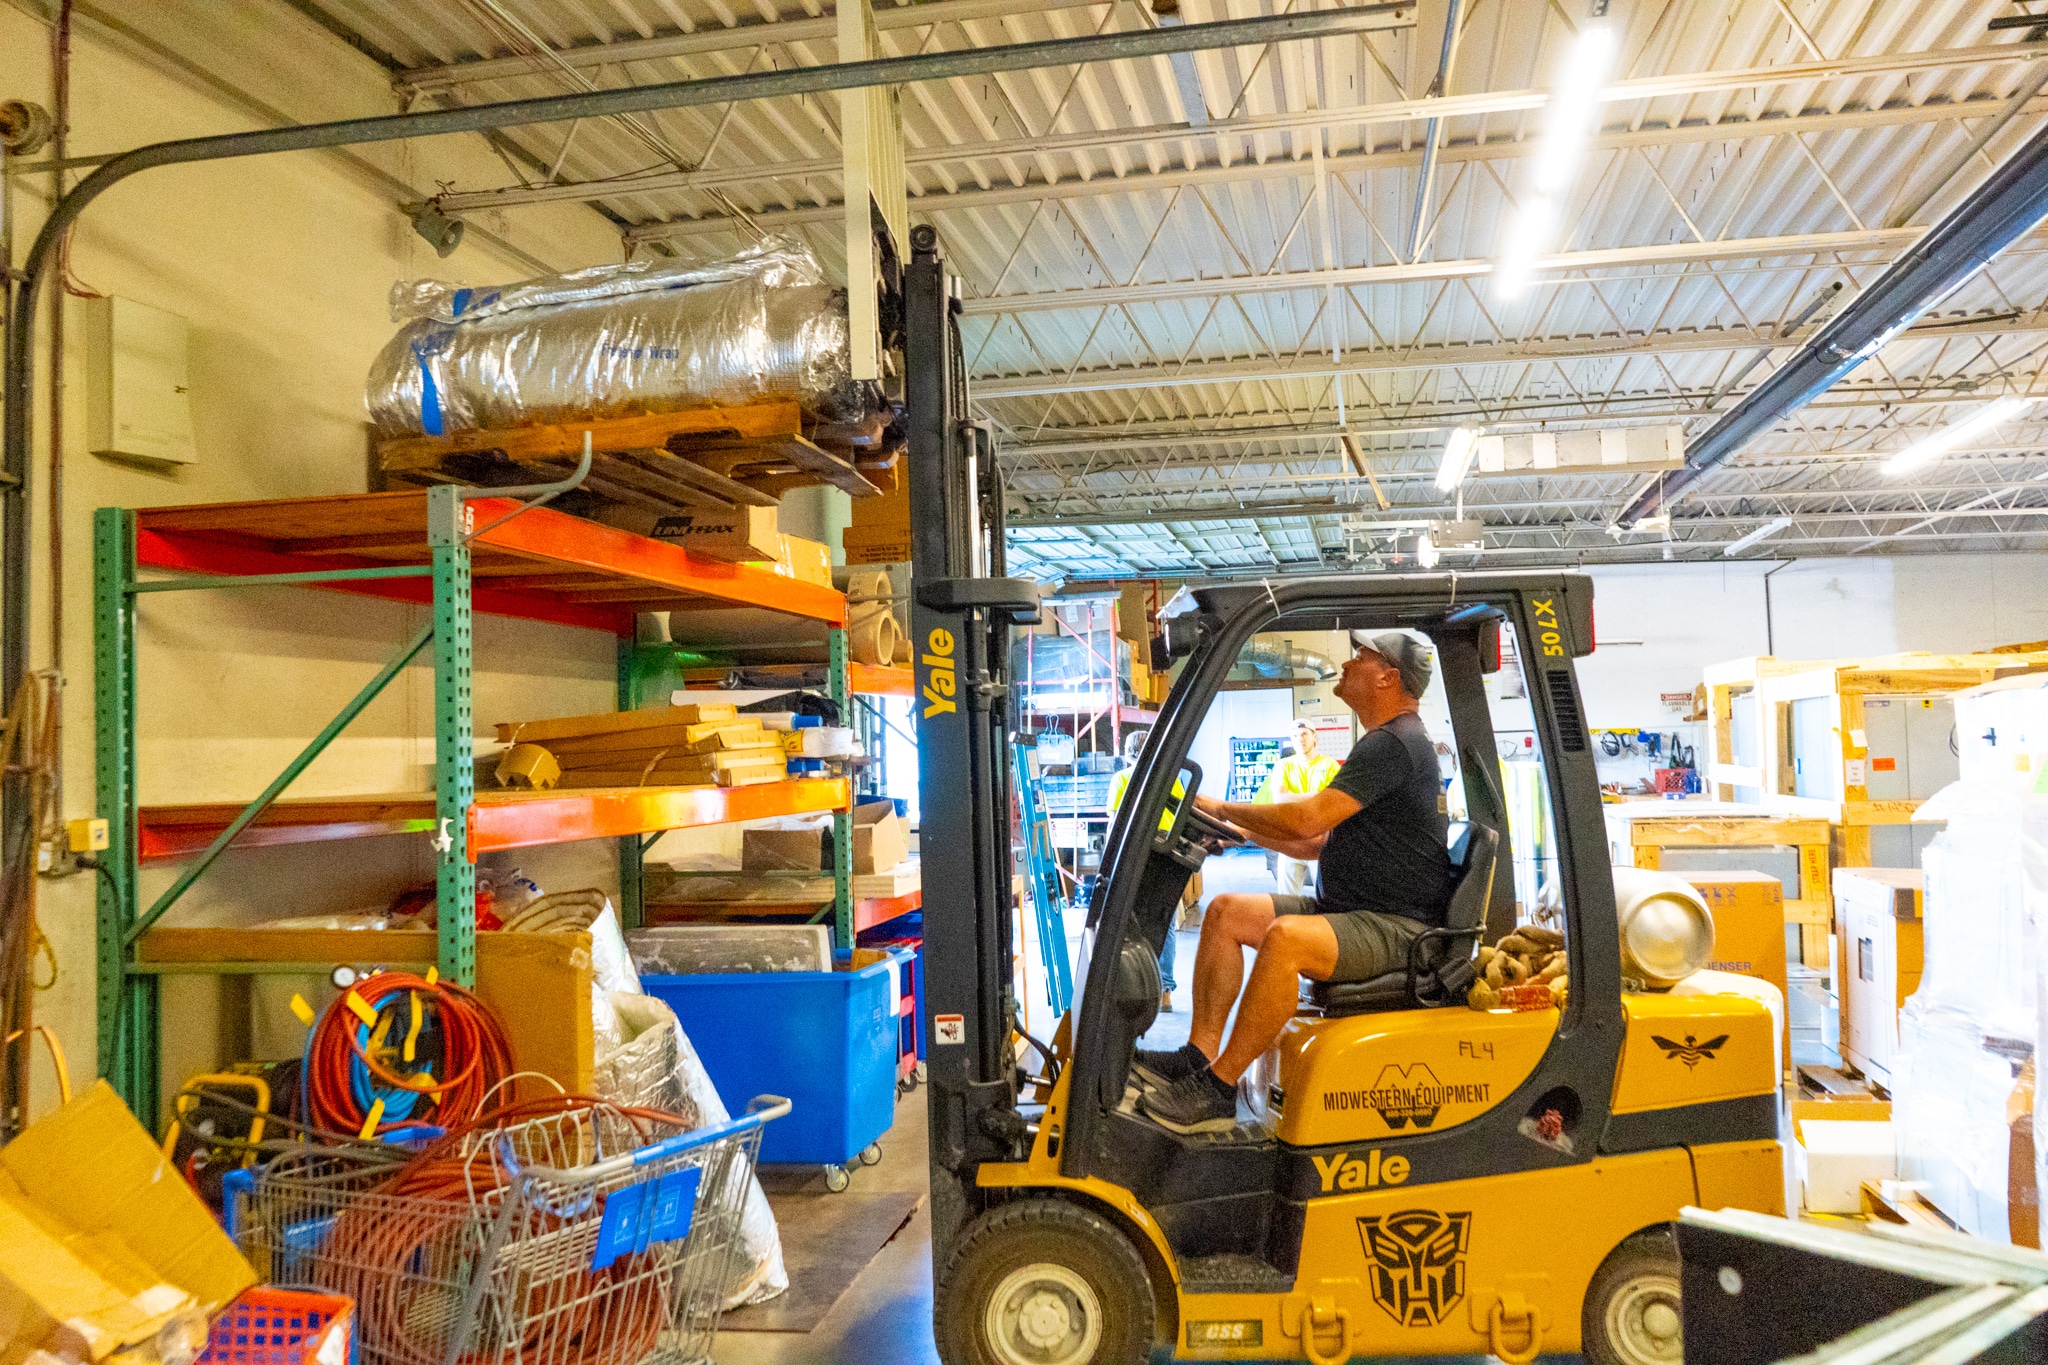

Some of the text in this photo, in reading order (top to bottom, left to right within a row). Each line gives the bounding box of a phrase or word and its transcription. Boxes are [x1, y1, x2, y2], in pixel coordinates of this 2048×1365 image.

[922, 627, 956, 719] Yale
[1808, 849, 1821, 884] STRAP HERE
[1324, 1084, 1490, 1111] MIDWESTERN EQUIPMENT
[1311, 1149, 1411, 1192] Yale
